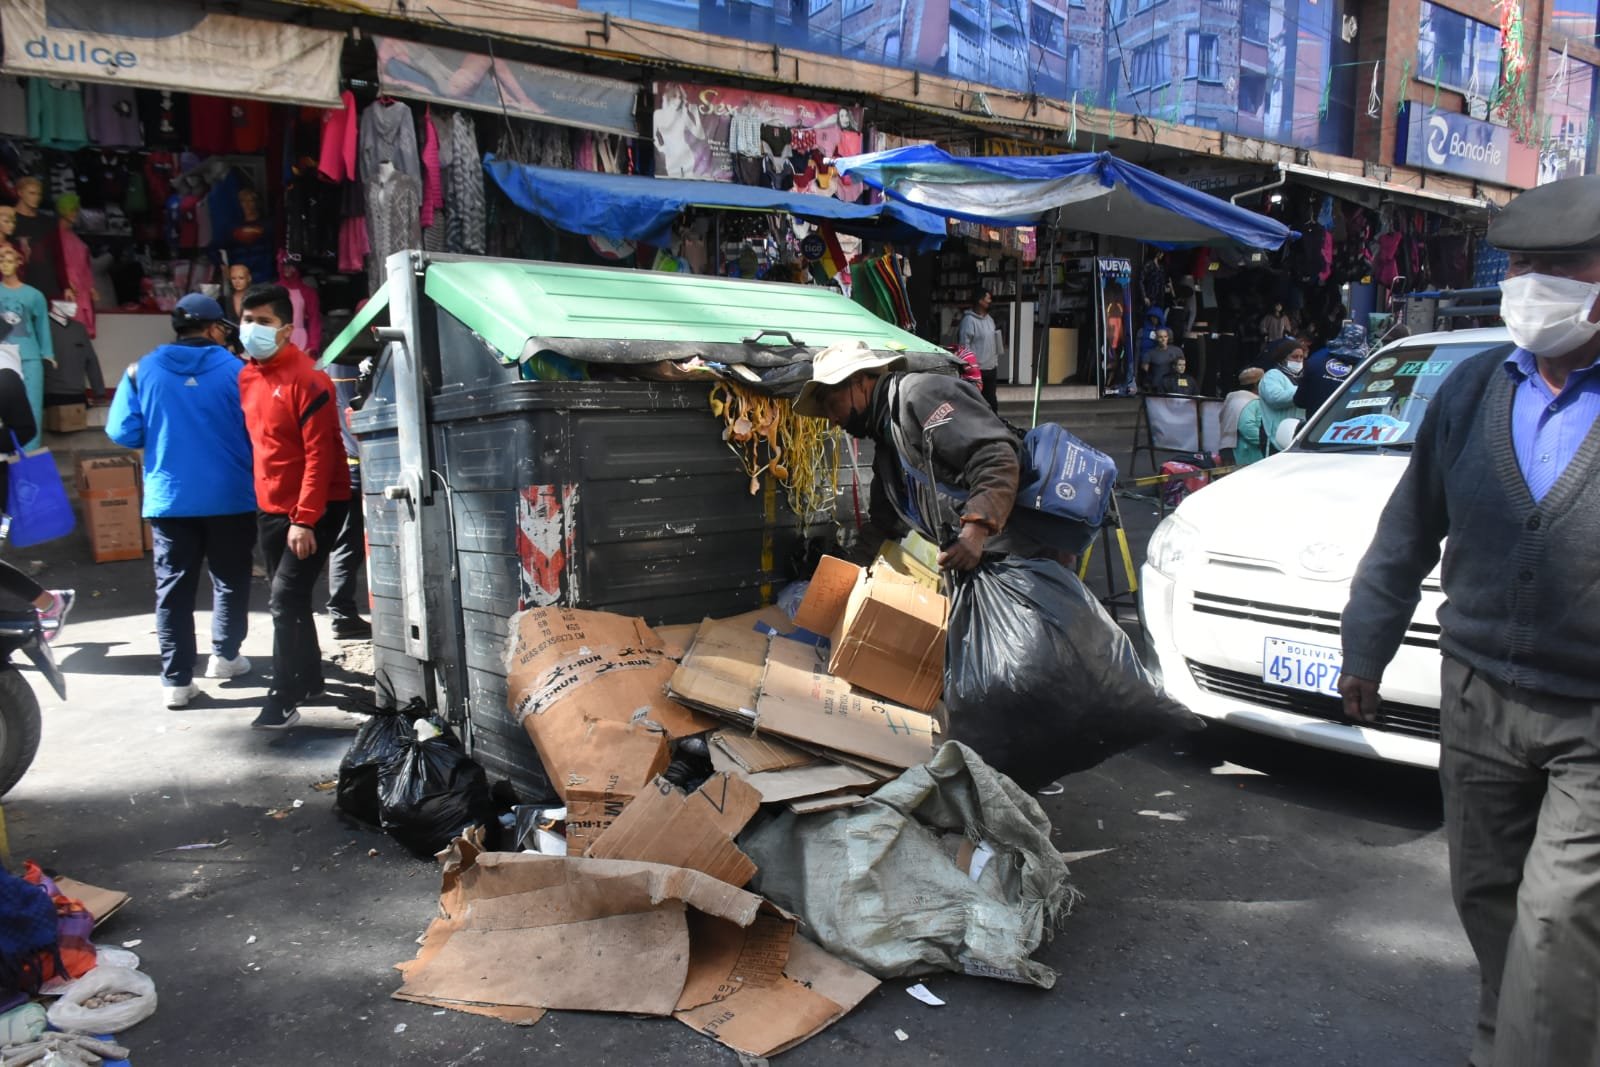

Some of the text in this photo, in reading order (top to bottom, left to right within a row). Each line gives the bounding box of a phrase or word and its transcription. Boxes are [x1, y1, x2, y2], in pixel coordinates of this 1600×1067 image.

[25, 35, 137, 68] dulce
[698, 89, 738, 116] Sex
[1099, 259, 1131, 273] NUEVA
[1402, 361, 1448, 374] TAXI
[1330, 424, 1399, 441] TAXI
[1287, 645, 1335, 660] BOLIVIA
[567, 654, 602, 671] I-RUN
[619, 659, 651, 668] I-RUN
[544, 674, 579, 702] I-RUN
